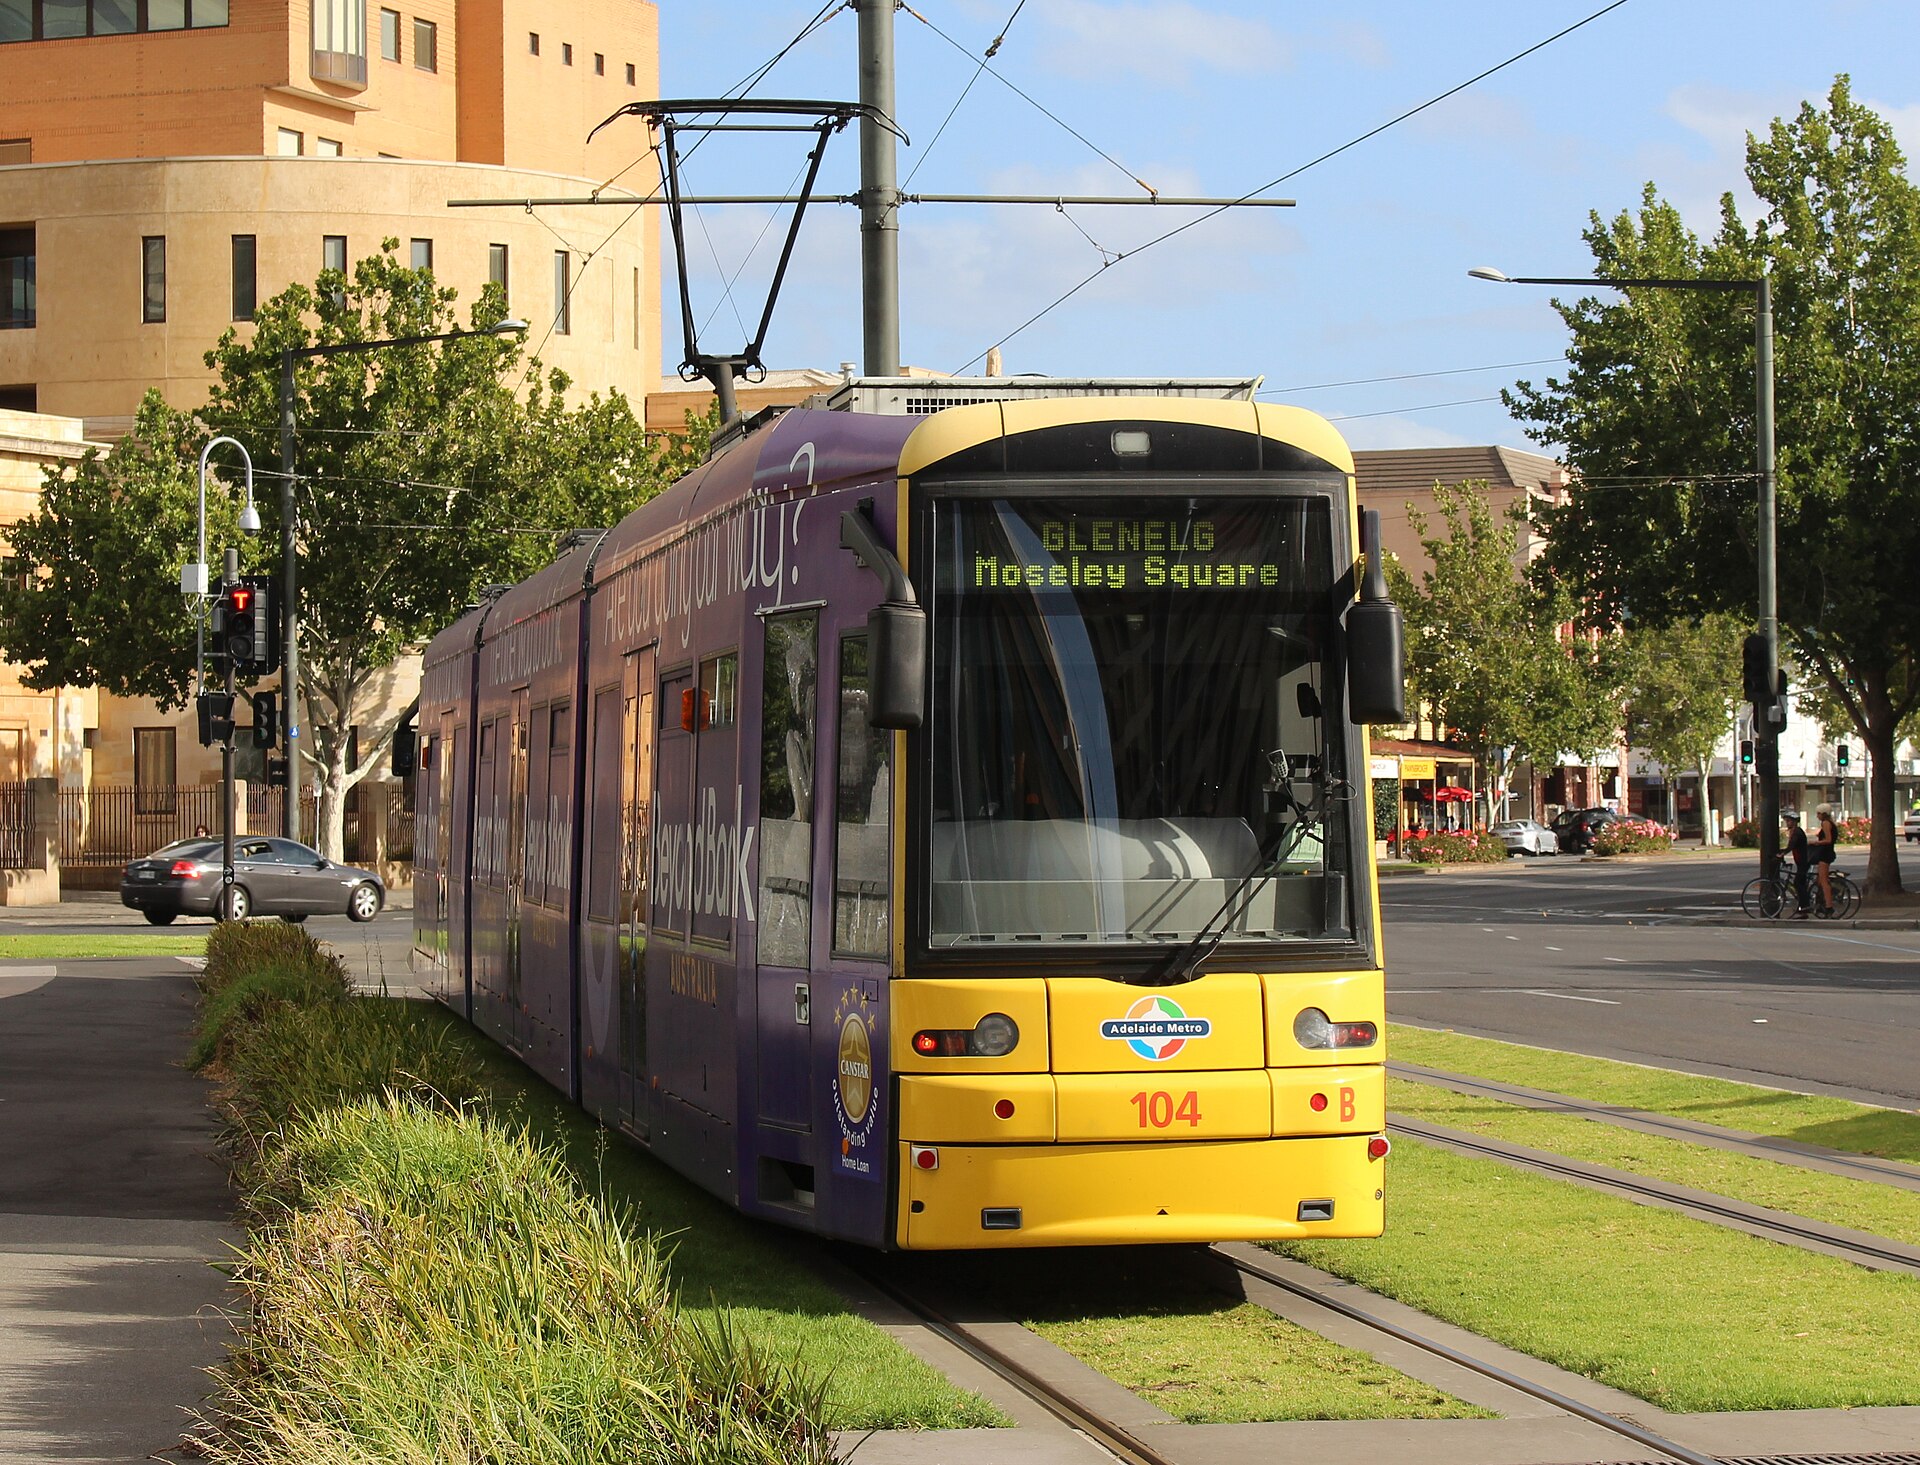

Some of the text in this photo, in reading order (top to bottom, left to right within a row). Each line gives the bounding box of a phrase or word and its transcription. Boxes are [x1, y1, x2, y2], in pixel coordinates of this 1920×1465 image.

[727, 442, 816, 624] way?
[1043, 521, 1215, 551] GLENELG
[975, 555, 1278, 588] Moseley Square
[670, 953, 718, 1004] AUSTRALIA
[1110, 1022, 1203, 1034] Adelaide Metro
[841, 1060, 868, 1079] CANSTAR
[833, 1079, 878, 1147] outstanding value
[1130, 1091, 1202, 1128] 104
[1340, 1087, 1356, 1122] B
[841, 1154, 869, 1173] Home Loan
